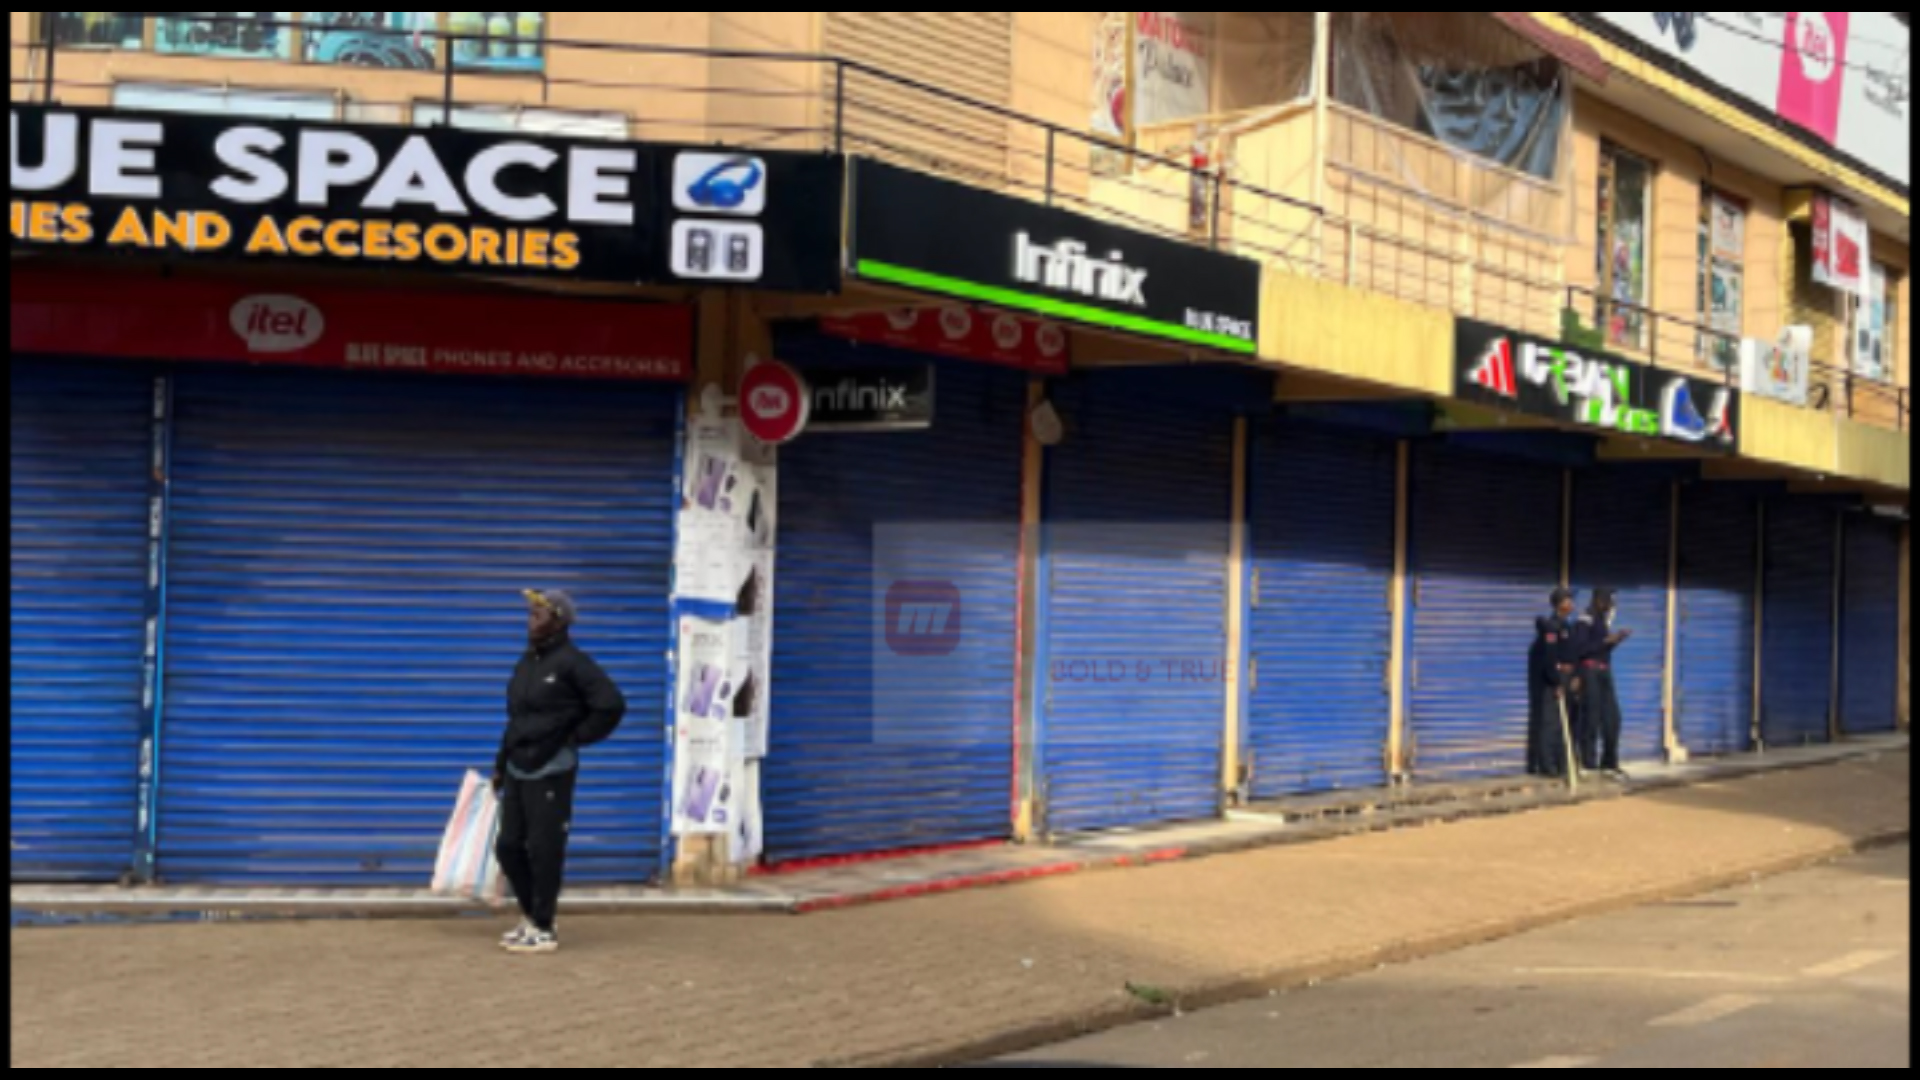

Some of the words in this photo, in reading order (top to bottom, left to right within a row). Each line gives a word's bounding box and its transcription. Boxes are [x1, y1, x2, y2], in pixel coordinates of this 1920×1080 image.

[209, 126, 637, 224] SPACE
[106, 208, 230, 249] AND
[246, 216, 580, 268] ACCESORIES
[1016, 231, 1147, 306] Infinix
[247, 302, 307, 337] itel
[517, 351, 556, 371] AND
[815, 376, 908, 412] nfinix
